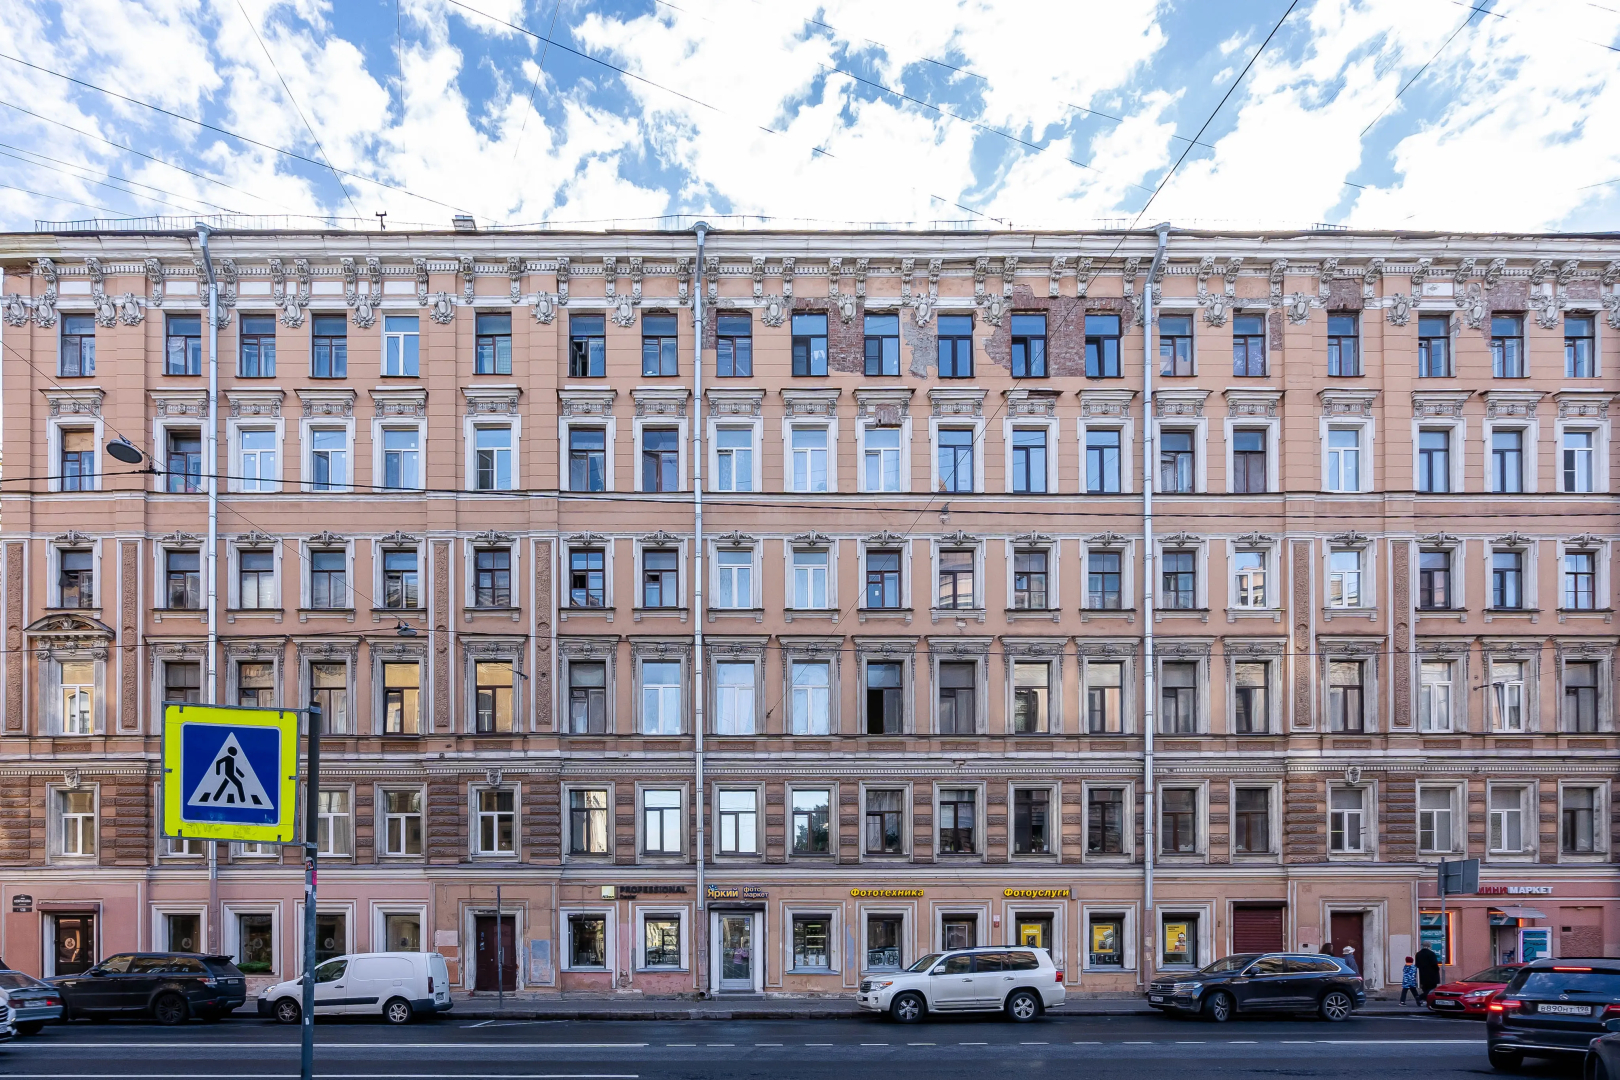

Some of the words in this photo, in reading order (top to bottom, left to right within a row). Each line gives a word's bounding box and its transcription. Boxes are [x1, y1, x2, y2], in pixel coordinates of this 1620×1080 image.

[707, 887, 739, 899] Яркий
[850, 888, 924, 897] Фототехника
[1004, 888, 1070, 898] Фотоуслуги
